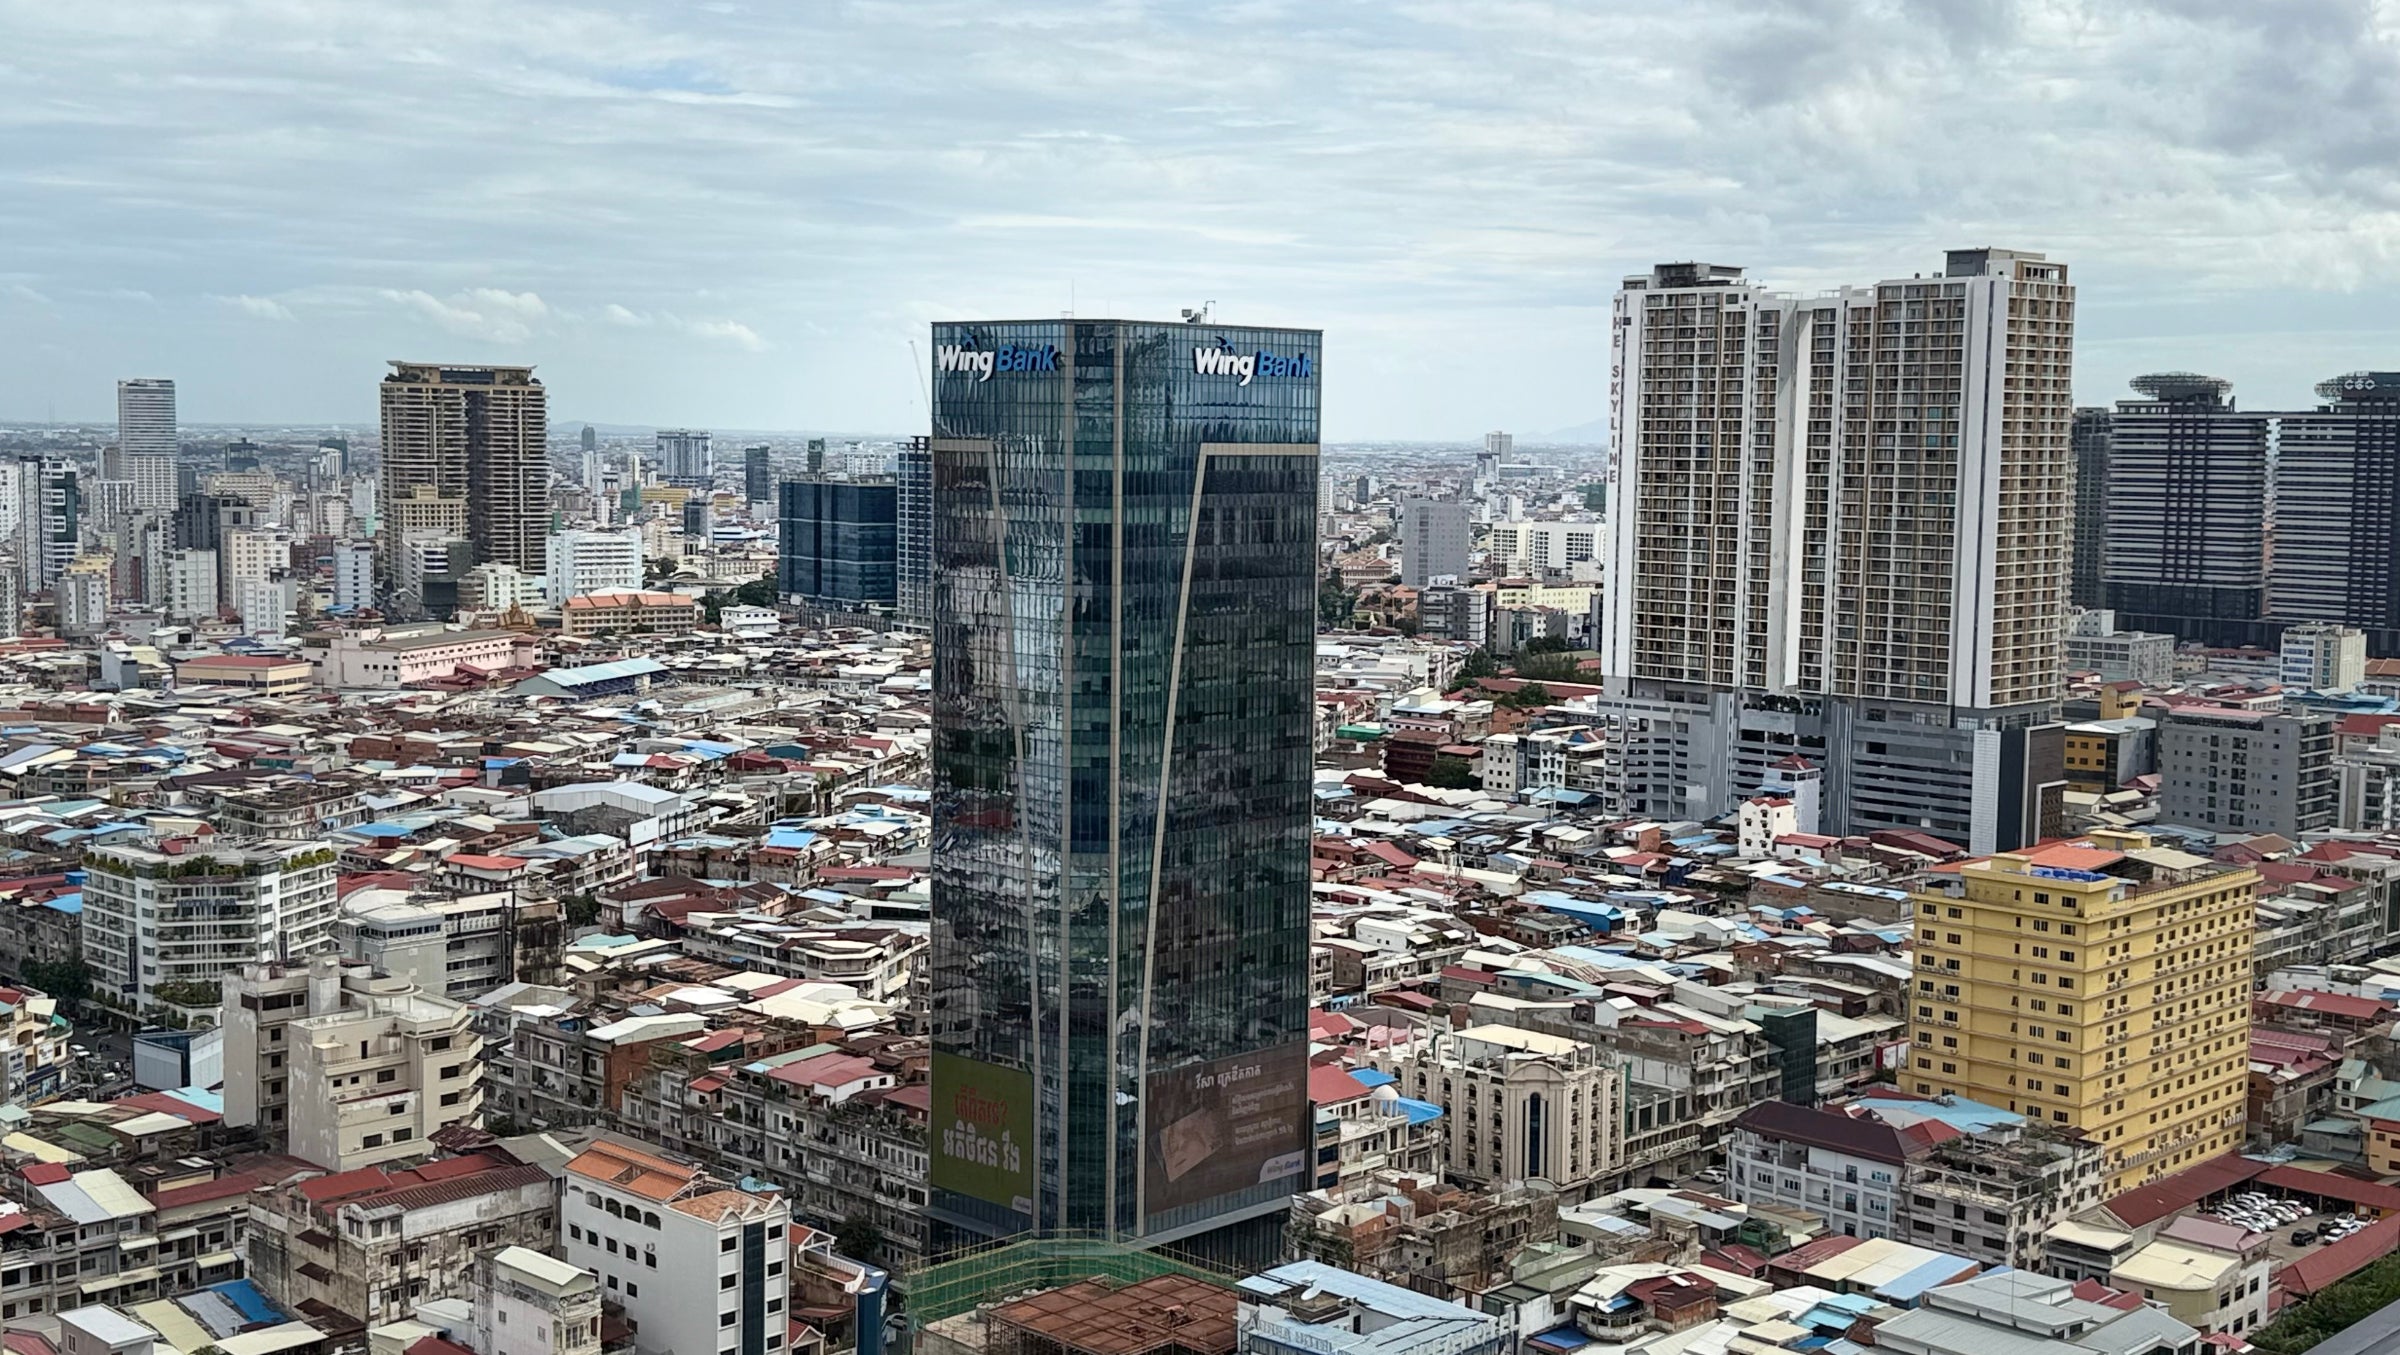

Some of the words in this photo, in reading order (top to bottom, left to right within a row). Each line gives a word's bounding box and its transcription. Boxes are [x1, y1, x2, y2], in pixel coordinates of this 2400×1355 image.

[1613, 298, 1622, 348] THE
[938, 343, 994, 382] Wing
[997, 343, 1057, 372] Bank
[1195, 346, 1255, 386] Wing
[1257, 350, 1312, 377] Bank
[1608, 365, 1620, 483] SKYLINE
